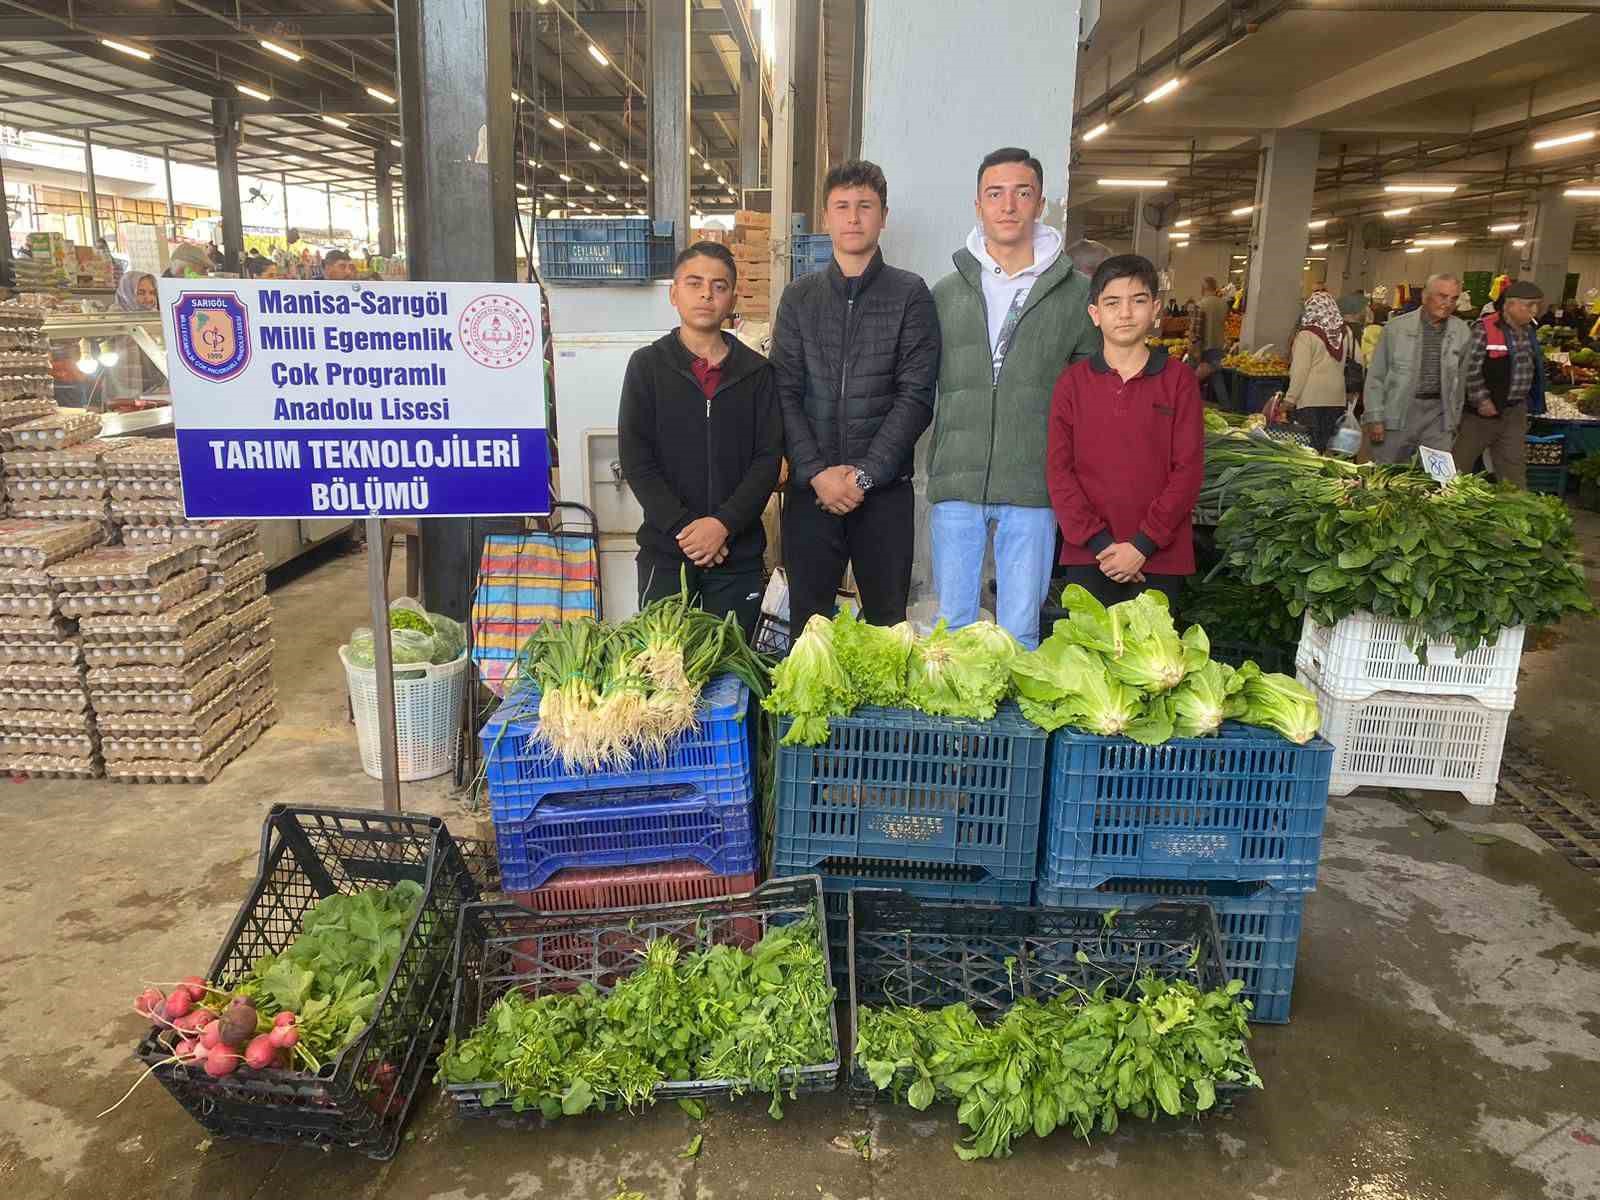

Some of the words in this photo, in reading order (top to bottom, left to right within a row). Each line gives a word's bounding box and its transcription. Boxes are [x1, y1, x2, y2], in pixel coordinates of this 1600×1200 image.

[258, 290, 448, 318] Manisa-Sarıgöl
[259, 326, 316, 350] Milli
[323, 326, 453, 353] Egemenlik
[271, 362, 319, 389] Çok
[326, 362, 446, 389] Programlı
[274, 398, 373, 421] Anadolu
[381, 398, 449, 421] Lisesi
[209, 440, 301, 469] TARIM
[308, 434, 520, 469] TEKNOLOJİLERİ
[311, 476, 430, 511] BÖLÜMÜ
